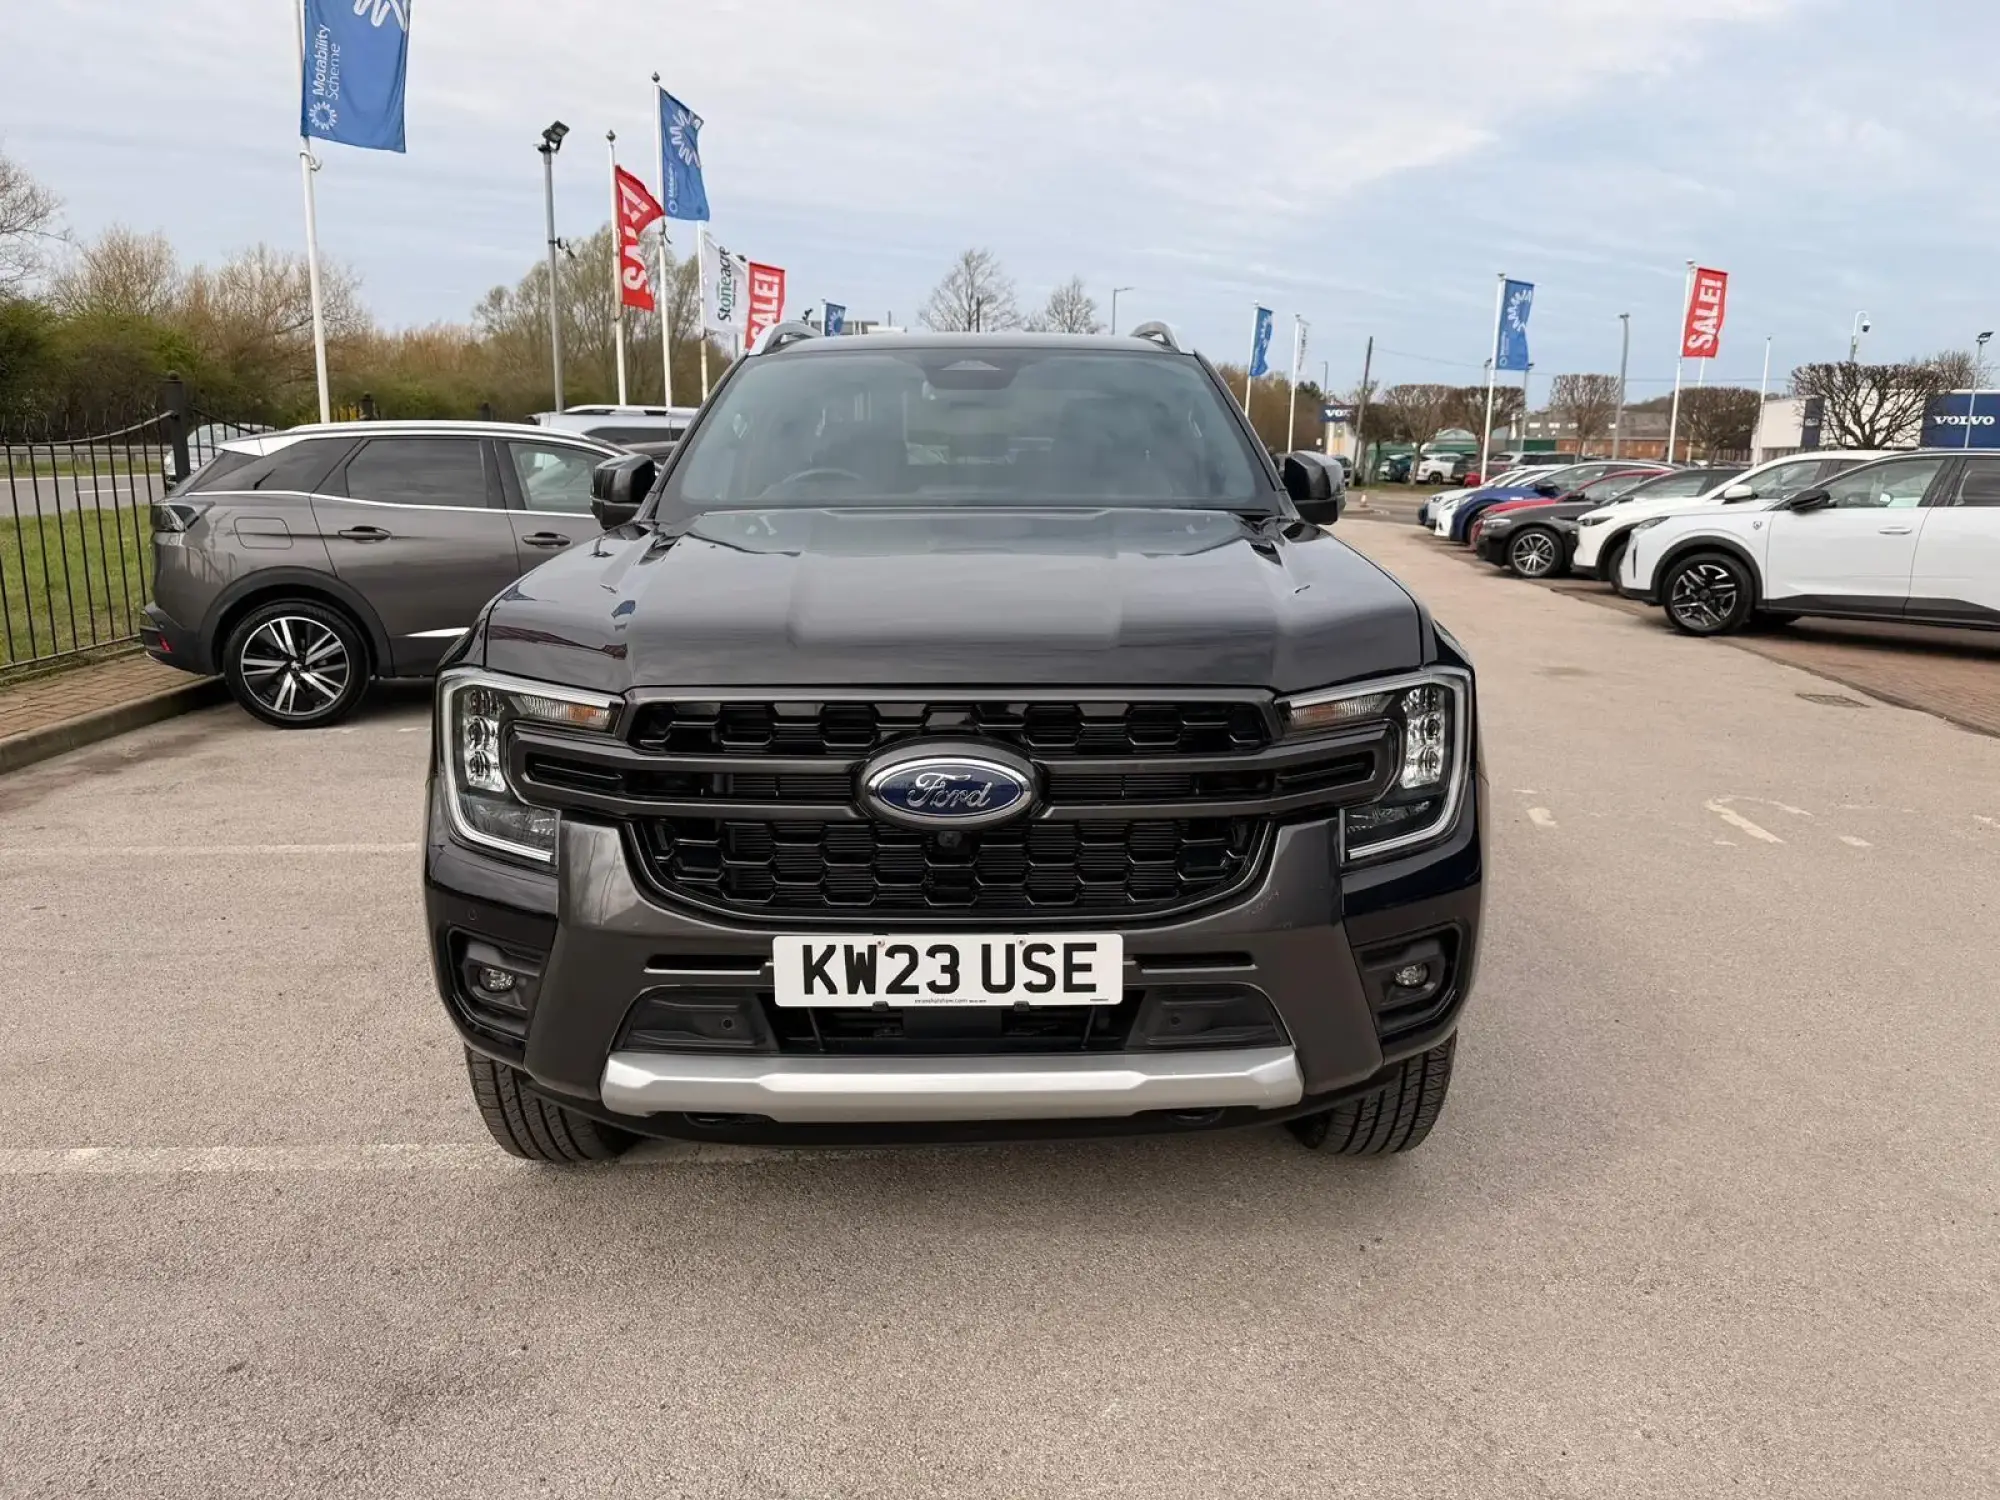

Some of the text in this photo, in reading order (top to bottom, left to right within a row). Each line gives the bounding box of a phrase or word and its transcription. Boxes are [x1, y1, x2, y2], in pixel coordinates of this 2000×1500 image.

[312, 23, 331, 96] Motability
[325, 42, 341, 101] Scheme
[717, 245, 731, 323] Stoneacre
[1686, 277, 1723, 351] SALE!
[1933, 415, 1996, 426] VOLVO
[906, 772, 993, 809] Ford
[802, 942, 1097, 996] KW23 USE
